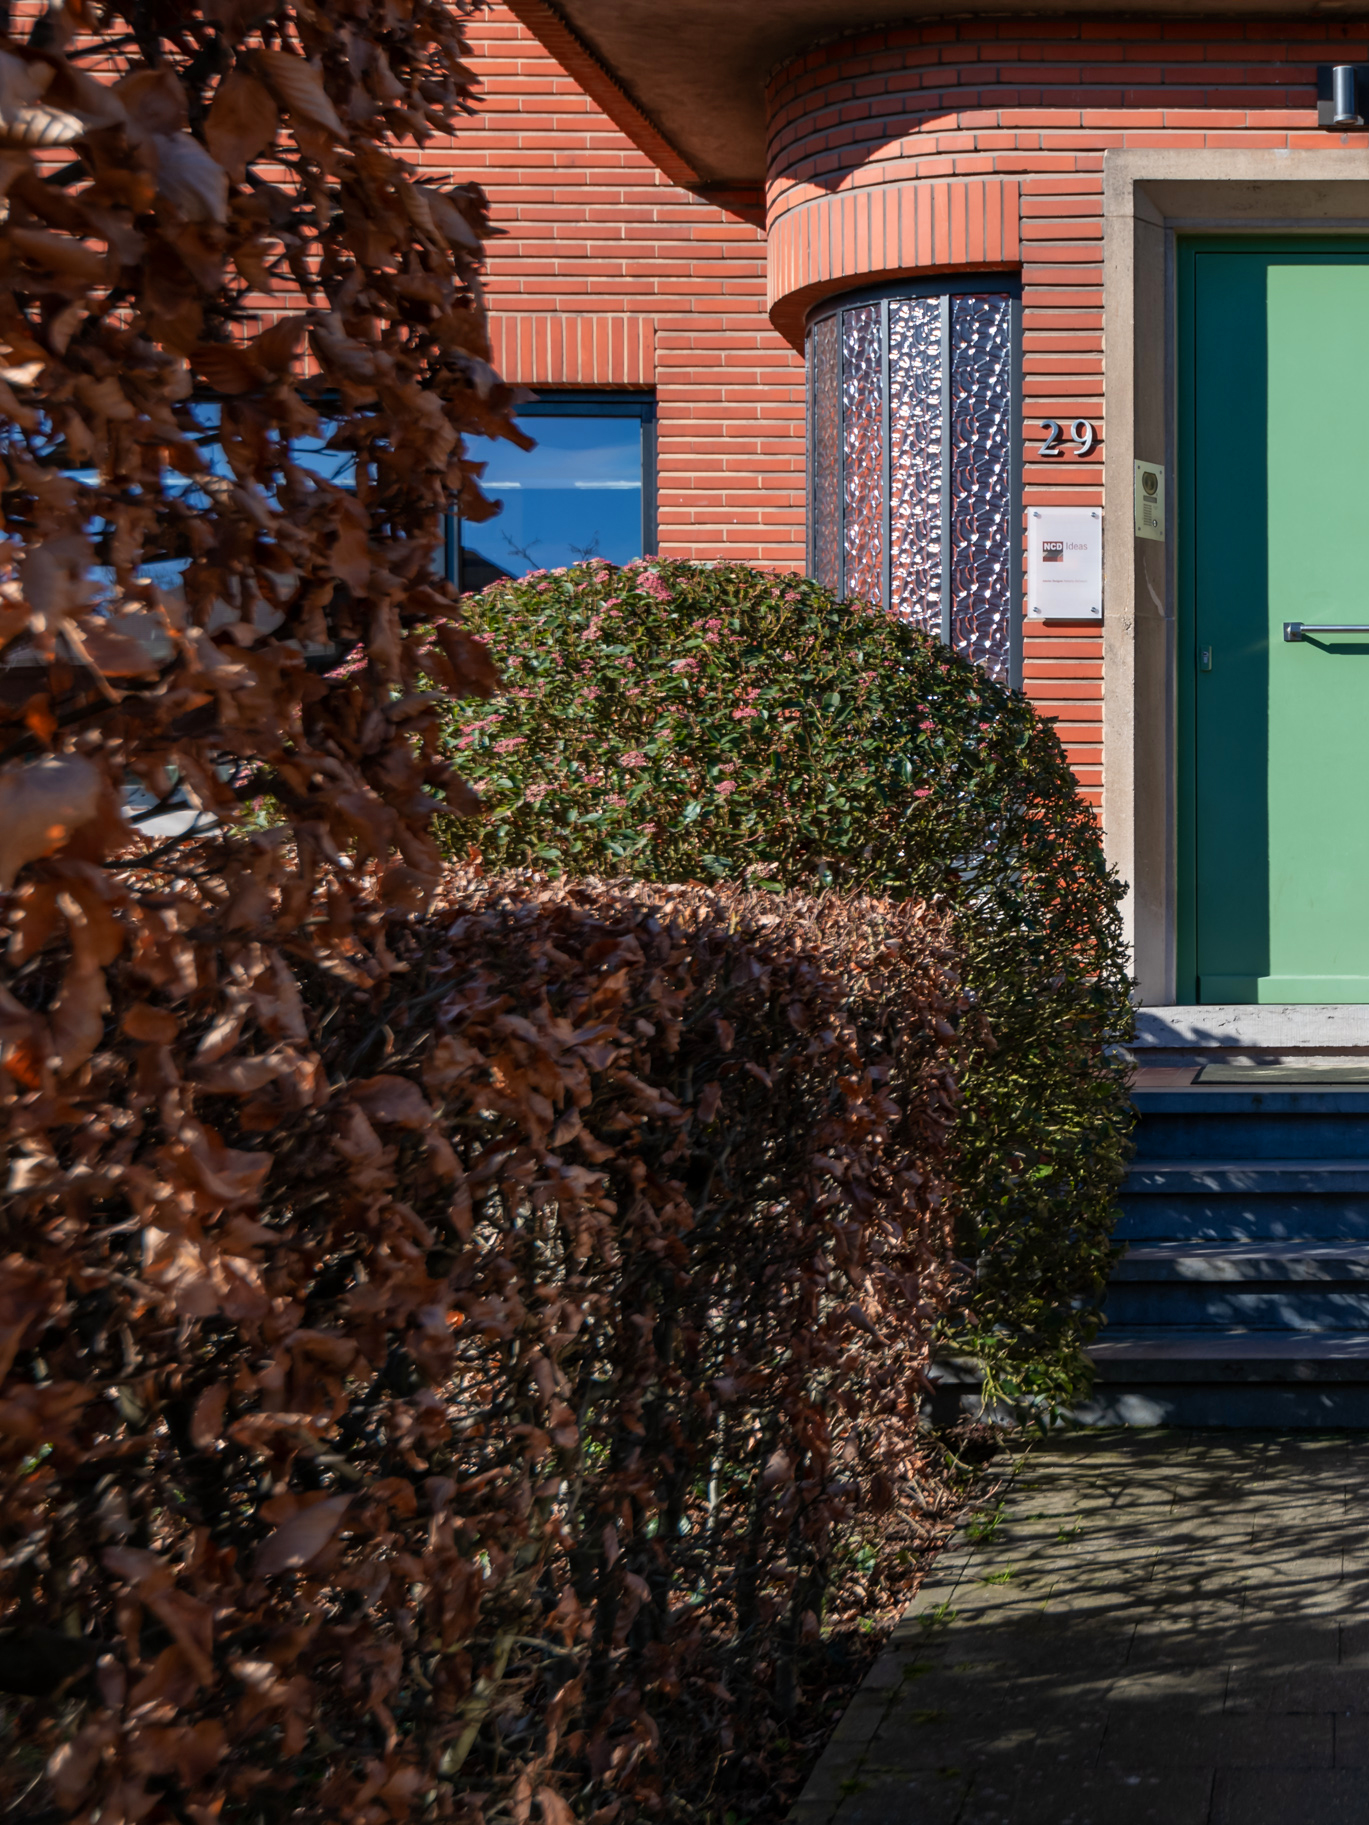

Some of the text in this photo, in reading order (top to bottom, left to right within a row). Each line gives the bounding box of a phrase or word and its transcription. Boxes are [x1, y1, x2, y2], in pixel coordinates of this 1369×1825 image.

[1037, 419, 1093, 455] 29
[1043, 541, 1088, 551] NCD Ideas
